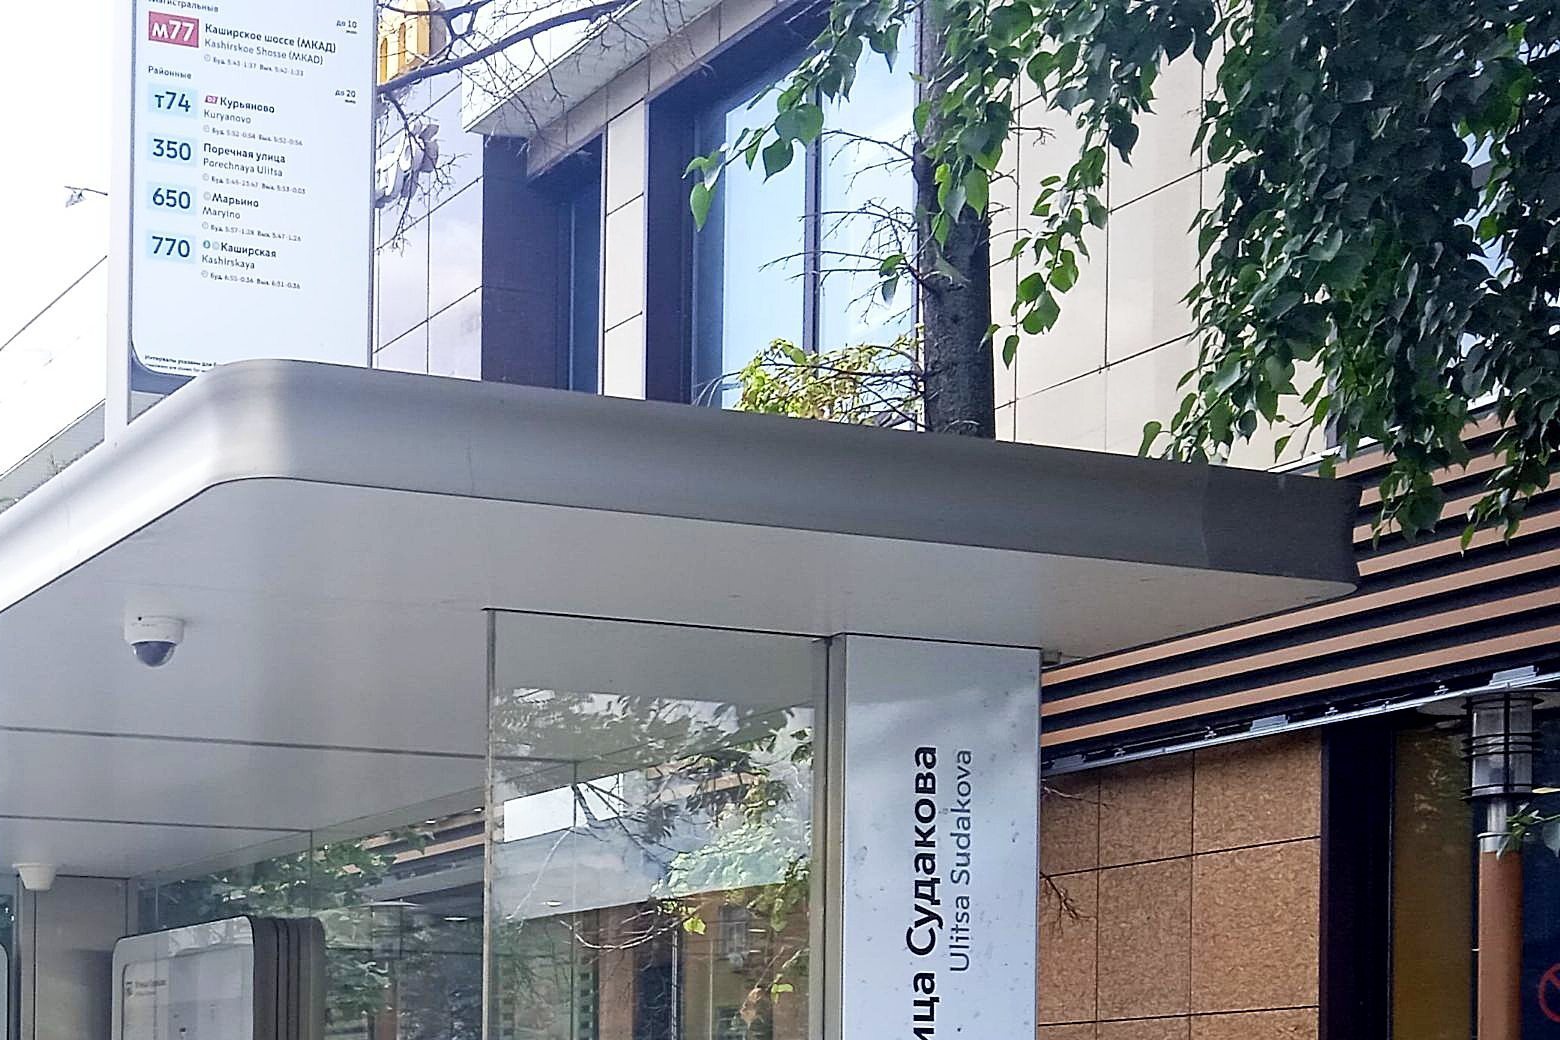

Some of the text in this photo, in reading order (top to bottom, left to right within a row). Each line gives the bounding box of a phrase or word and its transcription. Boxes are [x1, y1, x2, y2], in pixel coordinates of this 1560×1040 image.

[347, 20, 357, 28] 10
[205, 23, 336, 53] Каширское шоссе (МКАД)
[205, 38, 324, 65] Kashirskoe Shosse (MKAD)
[148, 65, 192, 79] Районные
[346, 89, 356, 98] 20
[220, 96, 275, 113] Курьяново
[204, 109, 252, 124] Kuryanovo
[152, 138, 191, 161] 350
[203, 143, 286, 164] Поречная улица
[203, 158, 283, 177] Porechnaya Ulitsa
[152, 187, 191, 209] 650
[212, 192, 259, 208] Марьино
[202, 206, 241, 219] Maryino
[152, 235, 190, 258] 770
[220, 241, 277, 258] Каширская
[202, 254, 255, 270] Kashirskaya
[906, 746, 943, 956] Судакова
[950, 749, 972, 973] Ulitsa Sudakova
